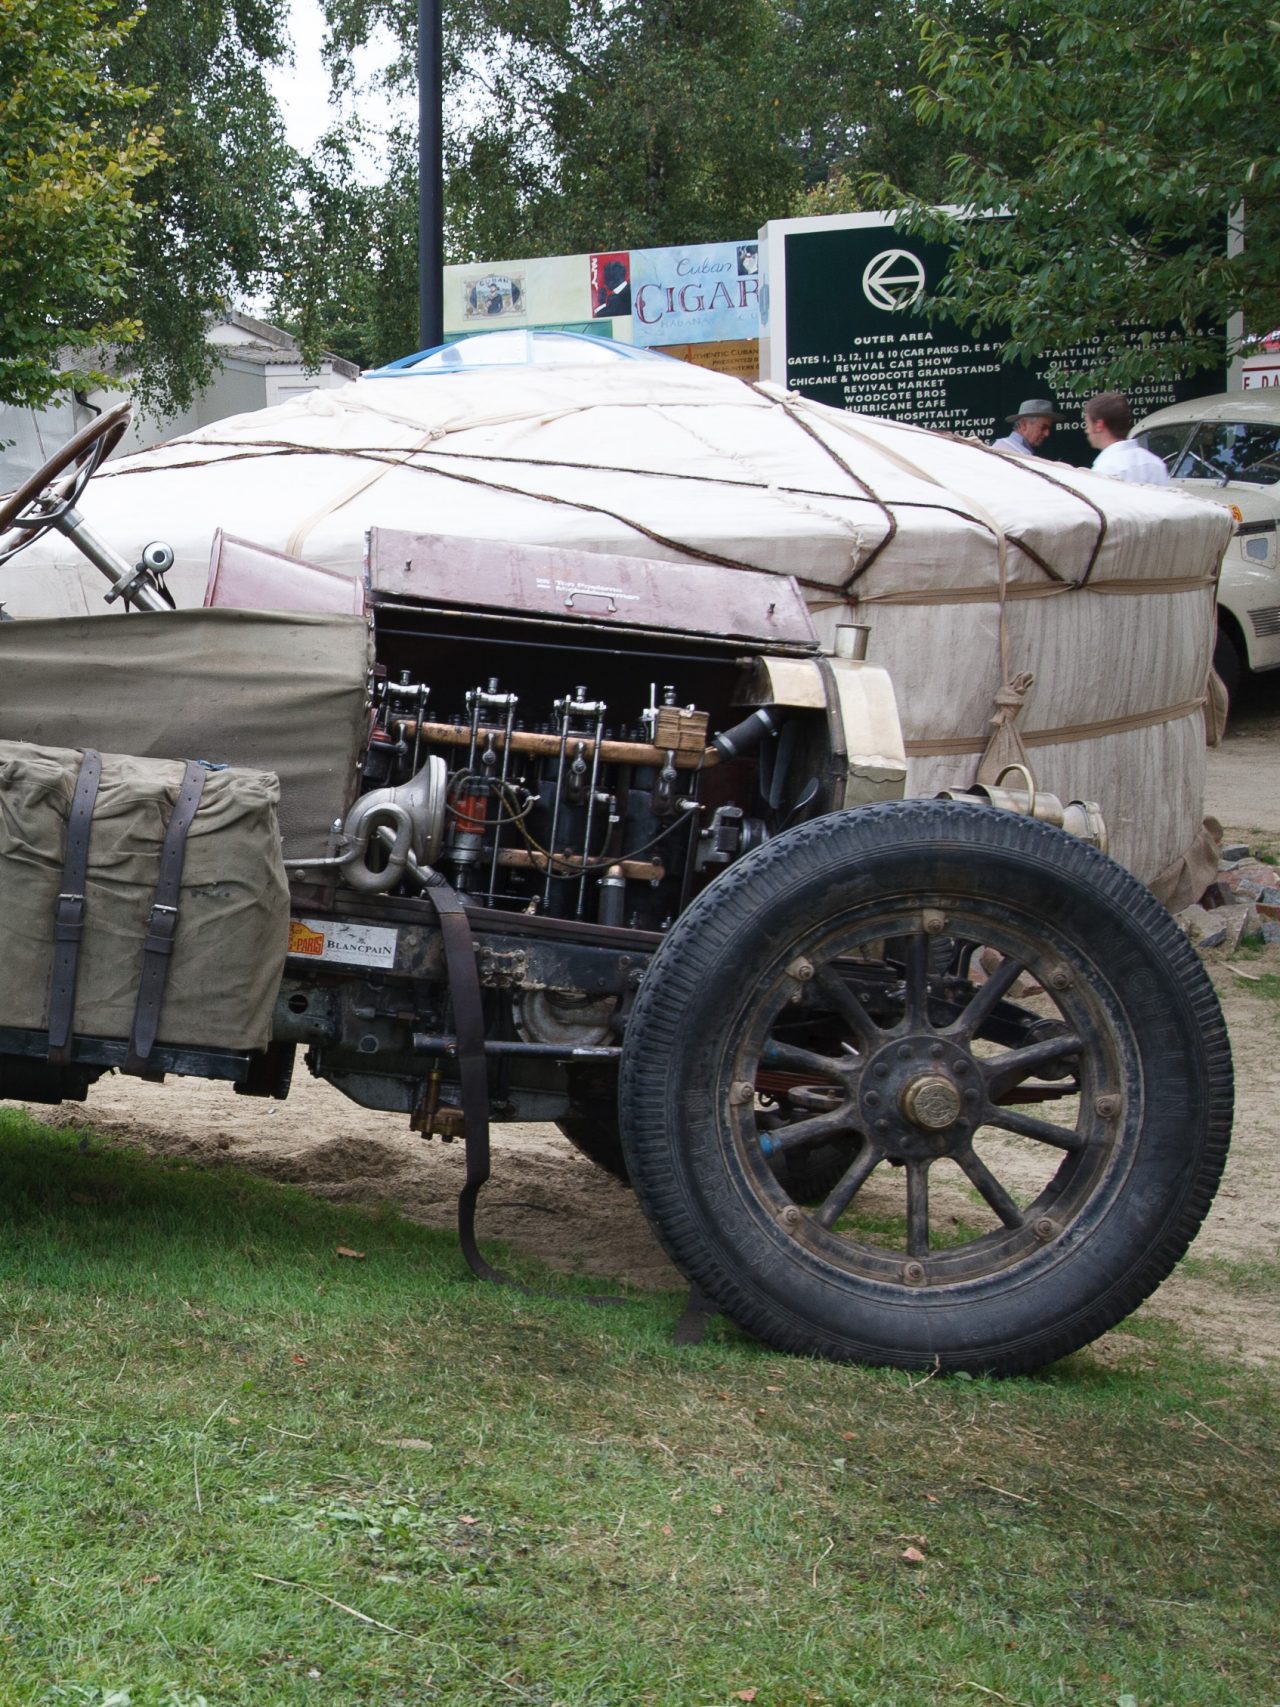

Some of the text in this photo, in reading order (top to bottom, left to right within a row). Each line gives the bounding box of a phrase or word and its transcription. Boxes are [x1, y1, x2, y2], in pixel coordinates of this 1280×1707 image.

[676, 256, 732, 277] Cuban
[1207, 327, 1215, 335] C
[854, 332, 933, 345] OUTER AREA
[787, 356, 819, 365] GATES
[823, 355, 830, 363] 1,
[833, 354, 845, 362] 13,
[849, 353, 862, 361] 12,
[877, 351, 884, 359] &
[888, 350, 897, 358] 10
[900, 348, 924, 359] (CAR
[927, 345, 959, 355] PARKS
[983, 343, 990, 351] &
[836, 357, 952, 373] REVIVAL CAR SHOW
[1049, 359, 1076, 368] OILY
[789, 364, 1001, 386] CHICANE & WOODCOTE GRANDSTANDS
[843, 379, 944, 393] REVIVAL MARKET
[844, 389, 947, 403] WOODCOTE BROS
[1126, 395, 1176, 406] VIEWING
[844, 400, 946, 413] HURRICANE CAFE
[896, 408, 969, 421] HOSPITALITY
[923, 418, 996, 429] TAXI PICKUP
[327, 940, 393, 954] BLANCPAIN
[1096, 924, 1187, 1119] MICHELIN
[681, 1088, 780, 1278] MICHELIN
